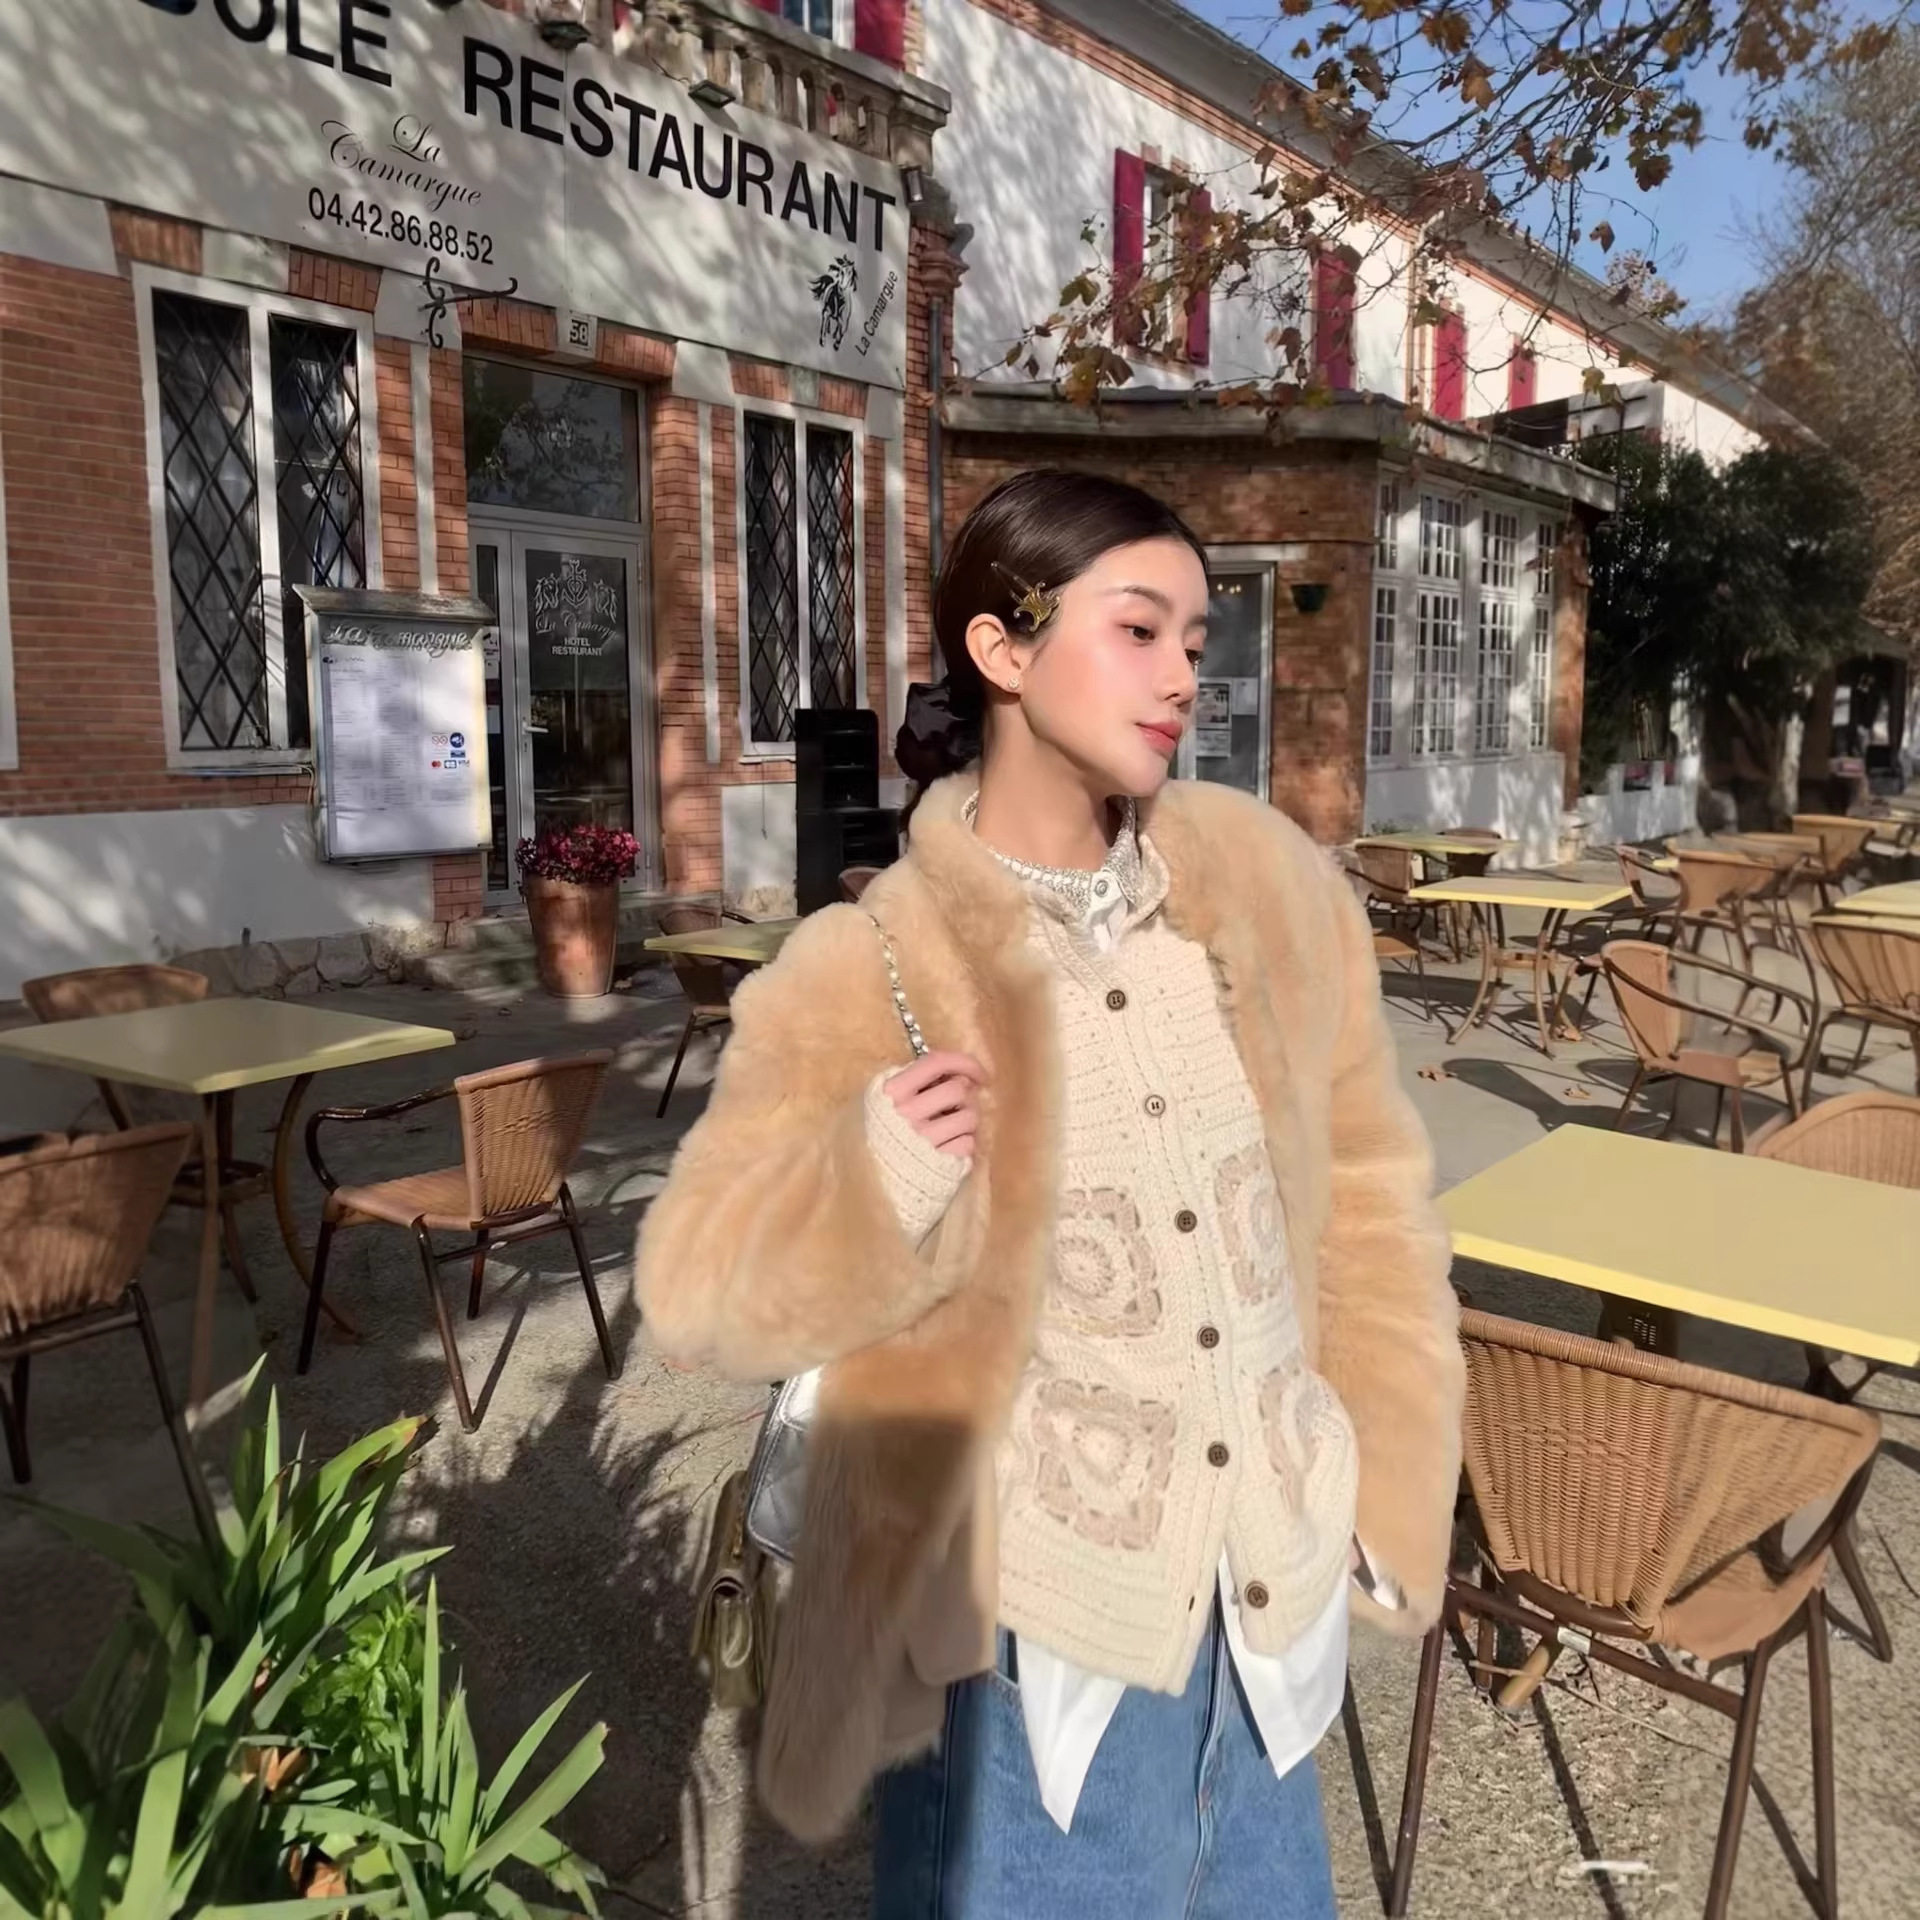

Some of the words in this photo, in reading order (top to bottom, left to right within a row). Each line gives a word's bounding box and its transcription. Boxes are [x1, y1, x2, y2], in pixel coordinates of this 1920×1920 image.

[321, 120, 482, 212] Camargue
[389, 114, 441, 163] La
[463, 36, 896, 252] RESTAURANT
[308, 187, 494, 264] 04.42.86.88.52
[855, 336, 871, 357] La
[864, 271, 898, 336] Camargue
[552, 646, 603, 656] RESTAURANT
[564, 637, 591, 647] HOTEL
